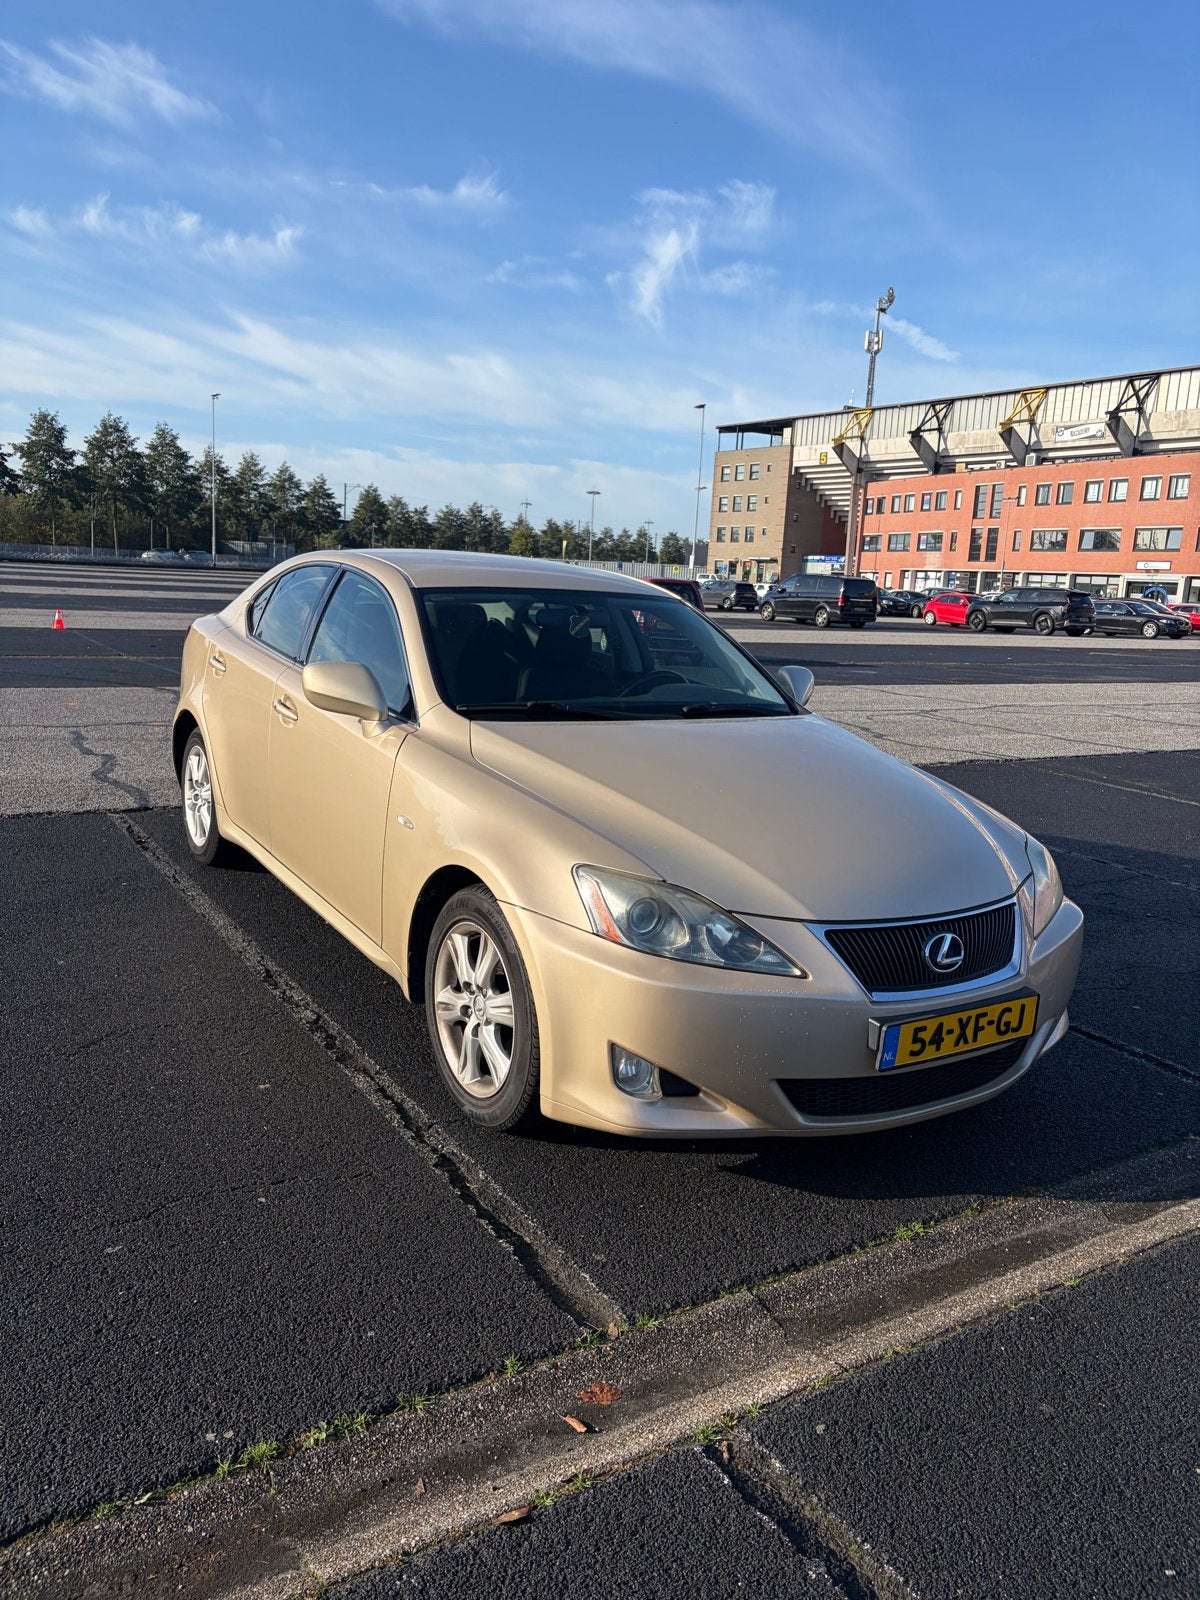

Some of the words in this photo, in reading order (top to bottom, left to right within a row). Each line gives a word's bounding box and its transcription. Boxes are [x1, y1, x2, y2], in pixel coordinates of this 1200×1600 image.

[821, 453, 827, 464] 5
[909, 1003, 1026, 1057] 54-XF-GJ
[883, 1051, 894, 1062] NL
